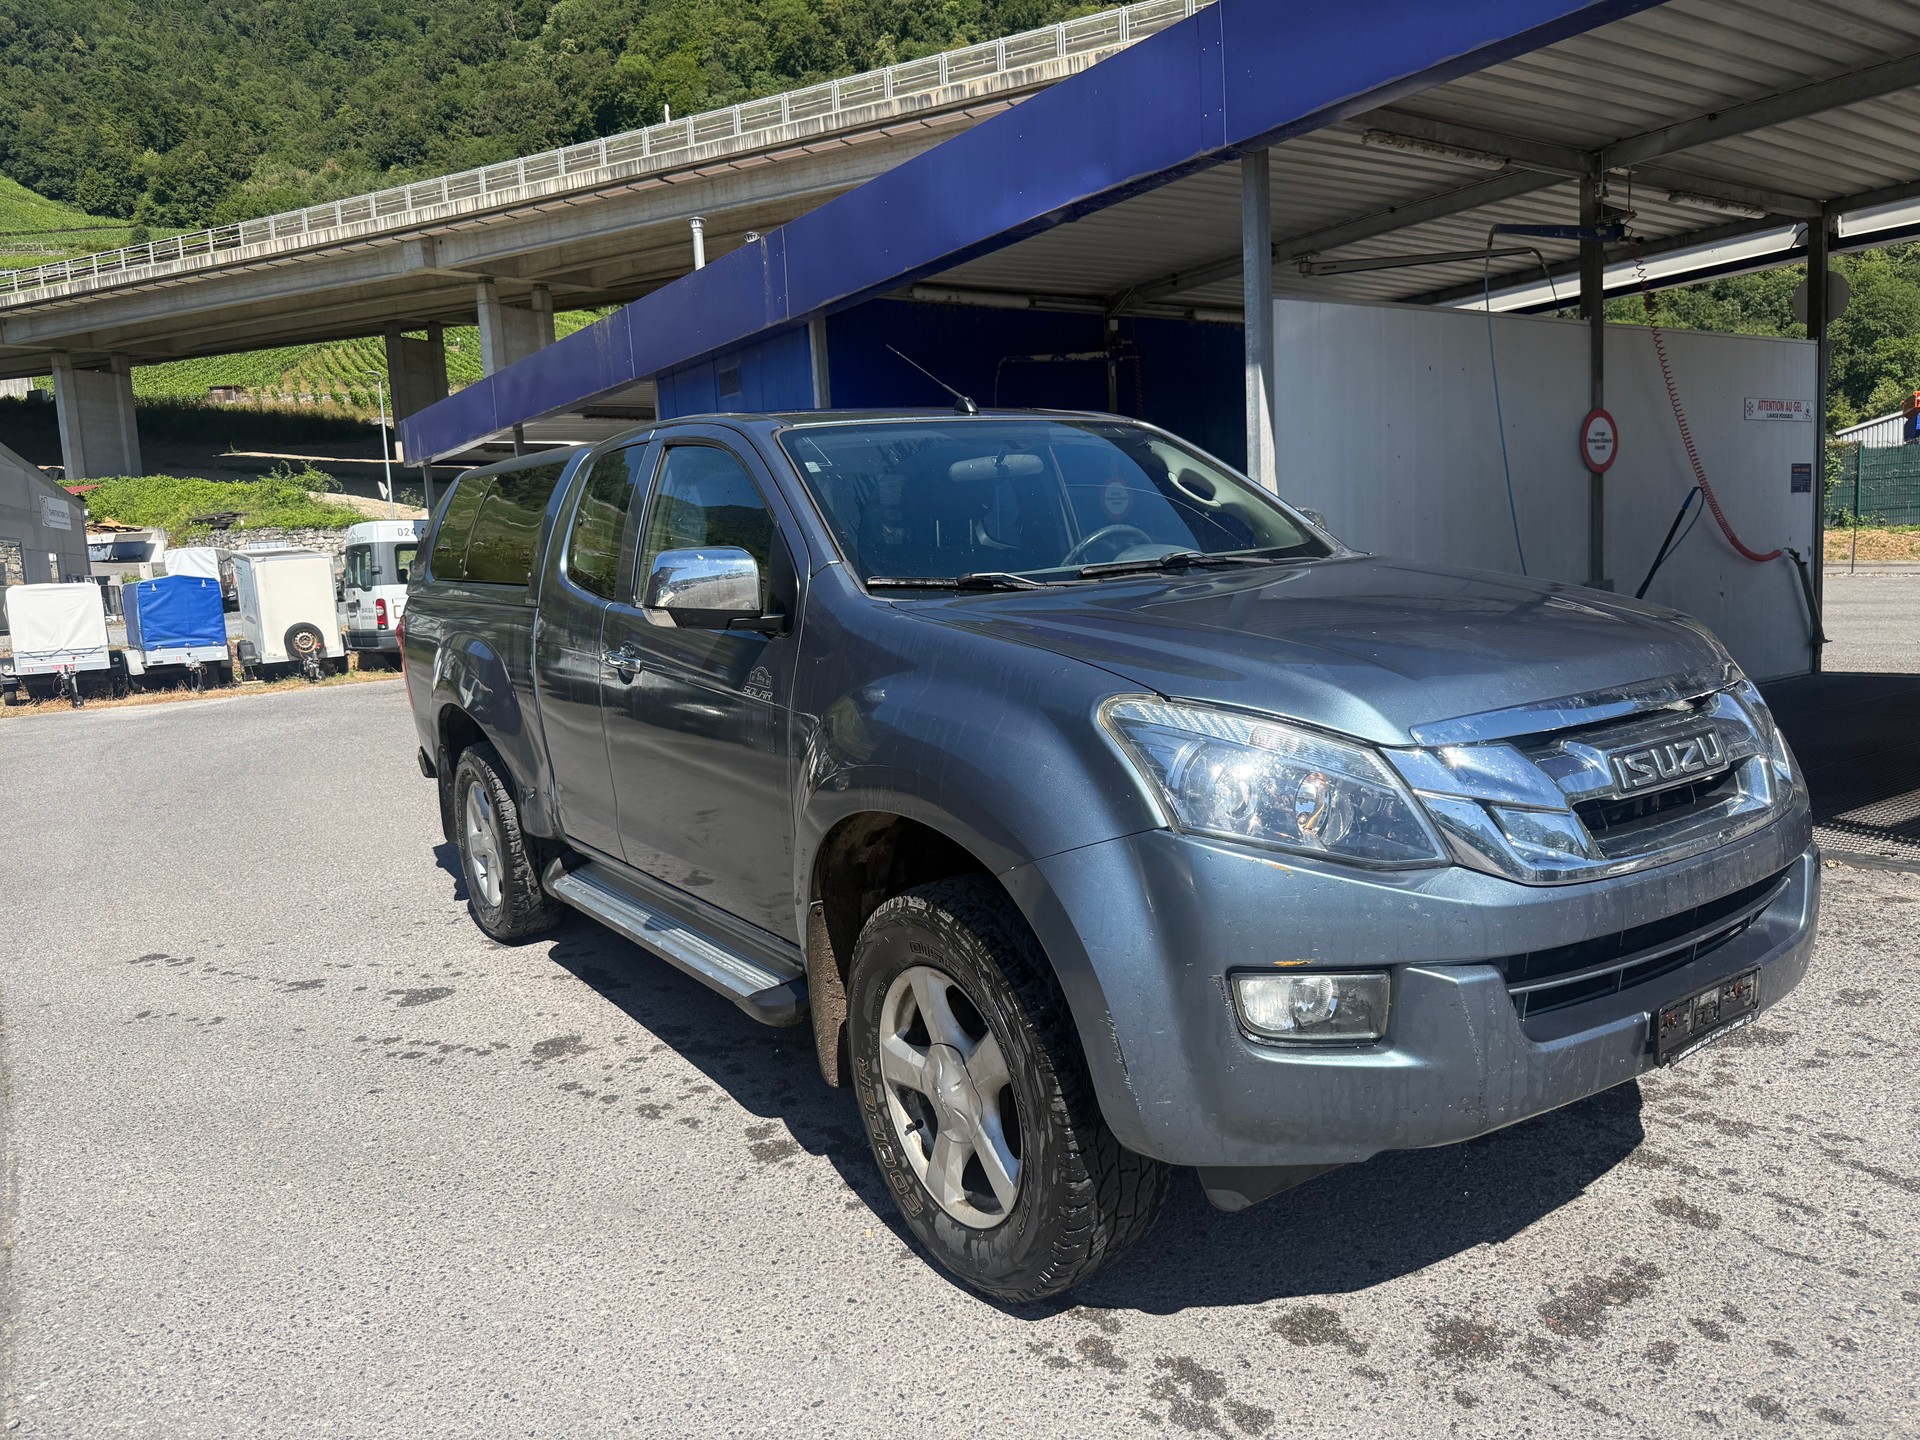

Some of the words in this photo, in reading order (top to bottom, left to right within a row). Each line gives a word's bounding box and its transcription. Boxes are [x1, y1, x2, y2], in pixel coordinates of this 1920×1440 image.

[1758, 400, 1785, 411] ATTENTION
[1785, 401, 1793, 412] AU
[1794, 401, 1802, 412] GEL
[742, 686, 773, 700] SOLAR
[1612, 733, 1724, 790] ISUZU
[856, 1056, 924, 1218] COOPER
